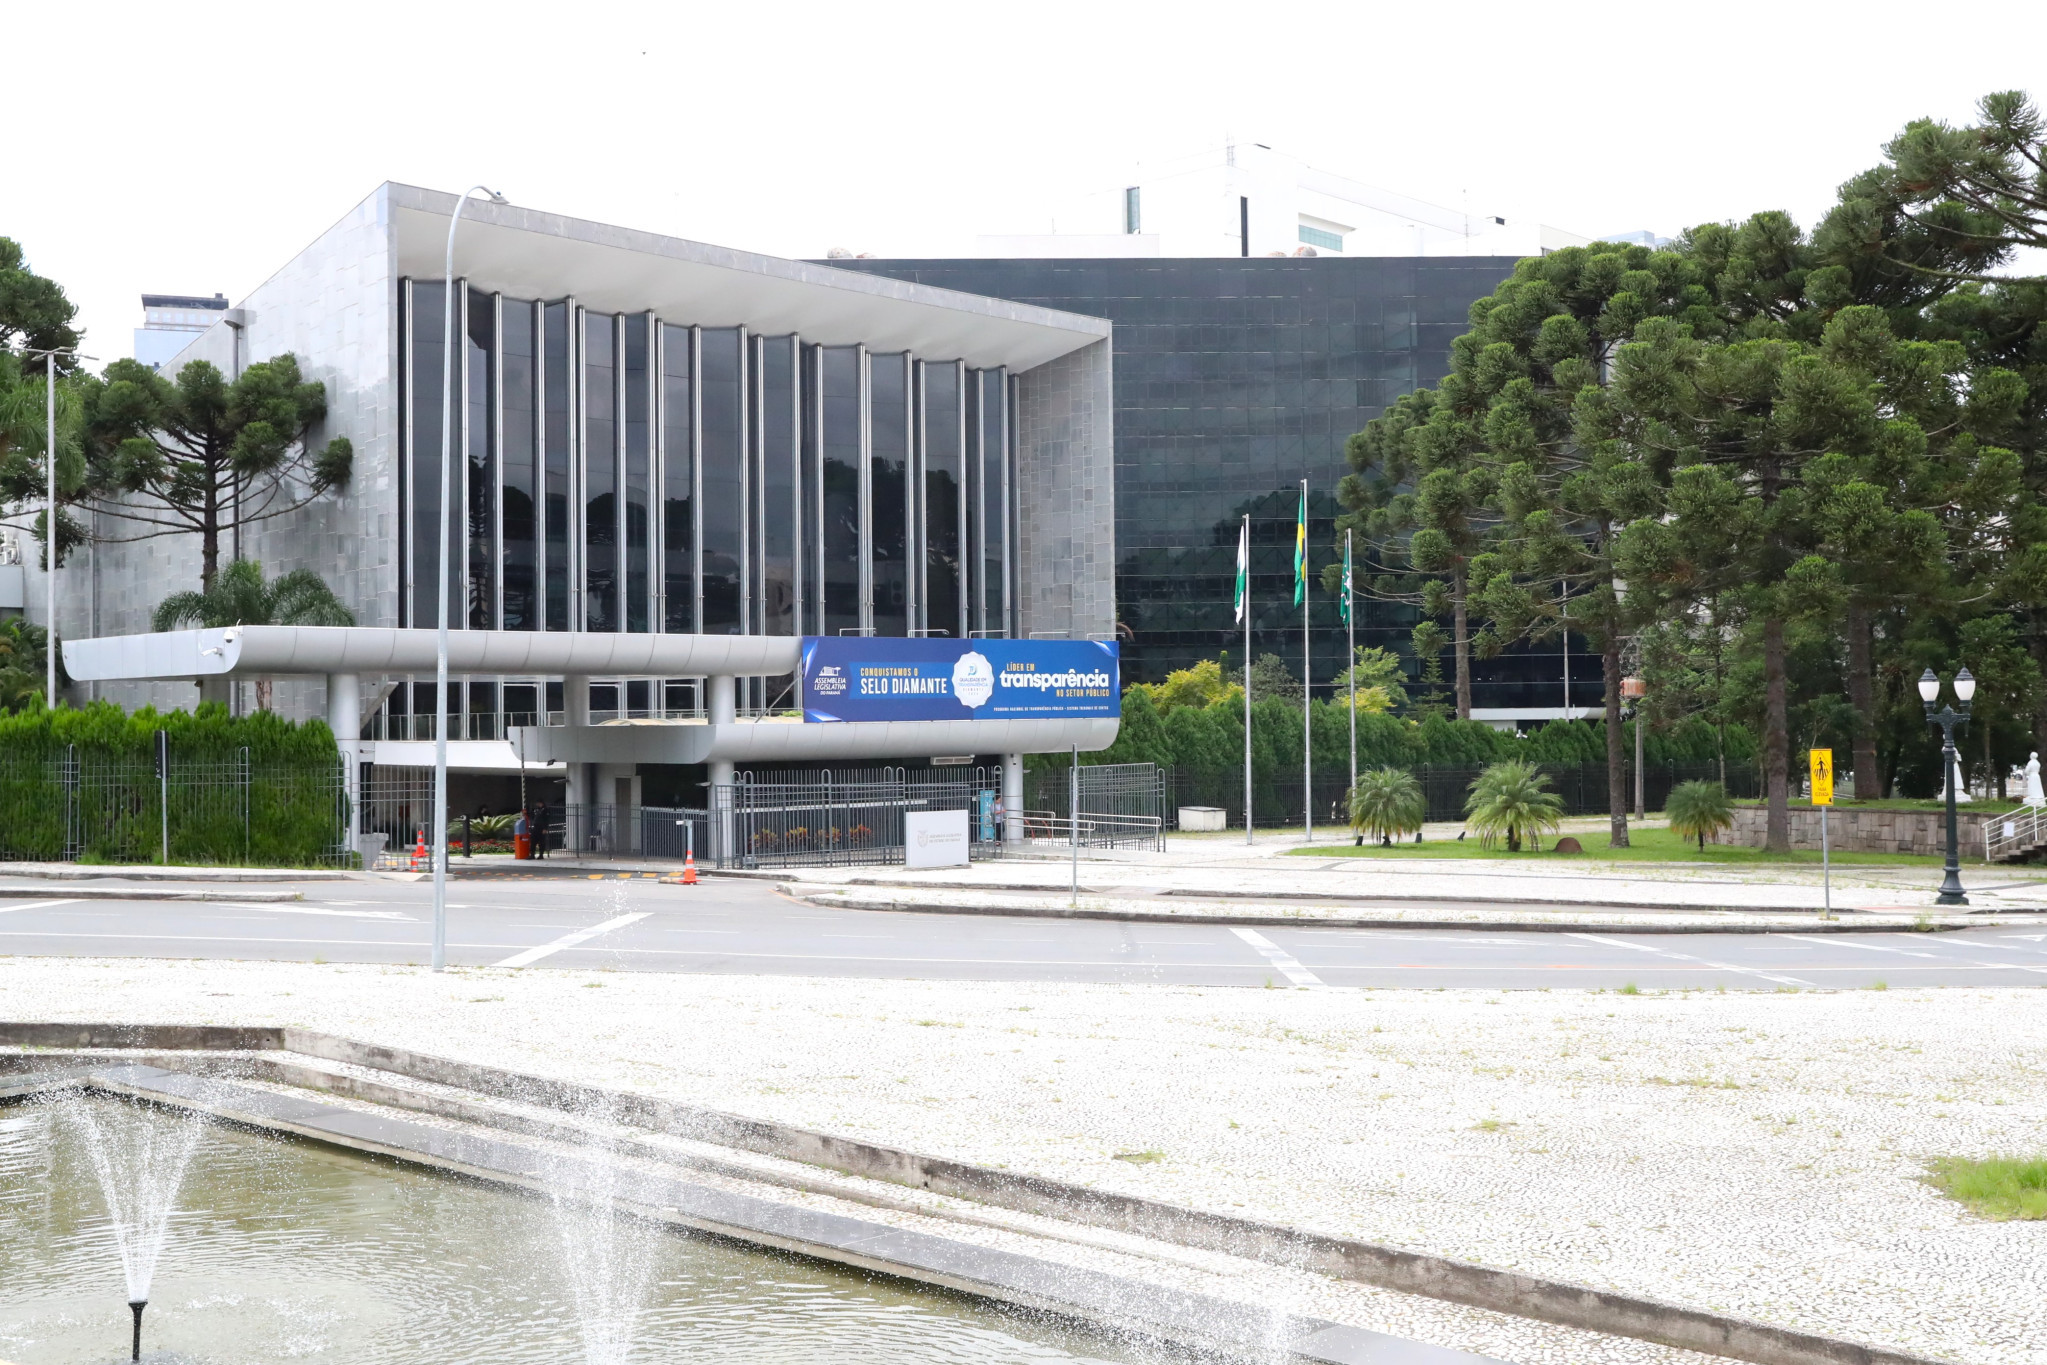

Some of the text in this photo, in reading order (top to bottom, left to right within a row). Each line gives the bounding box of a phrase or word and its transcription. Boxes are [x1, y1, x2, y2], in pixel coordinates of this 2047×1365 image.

[860, 668, 918, 676] CONQUISTAMOS O
[1006, 662, 1035, 672] LÍDER EM
[999, 668, 1109, 692] transparência
[860, 678, 947, 694] SELO DIAMANTE
[1056, 688, 1110, 697] NO SETOR PÚBLICO
